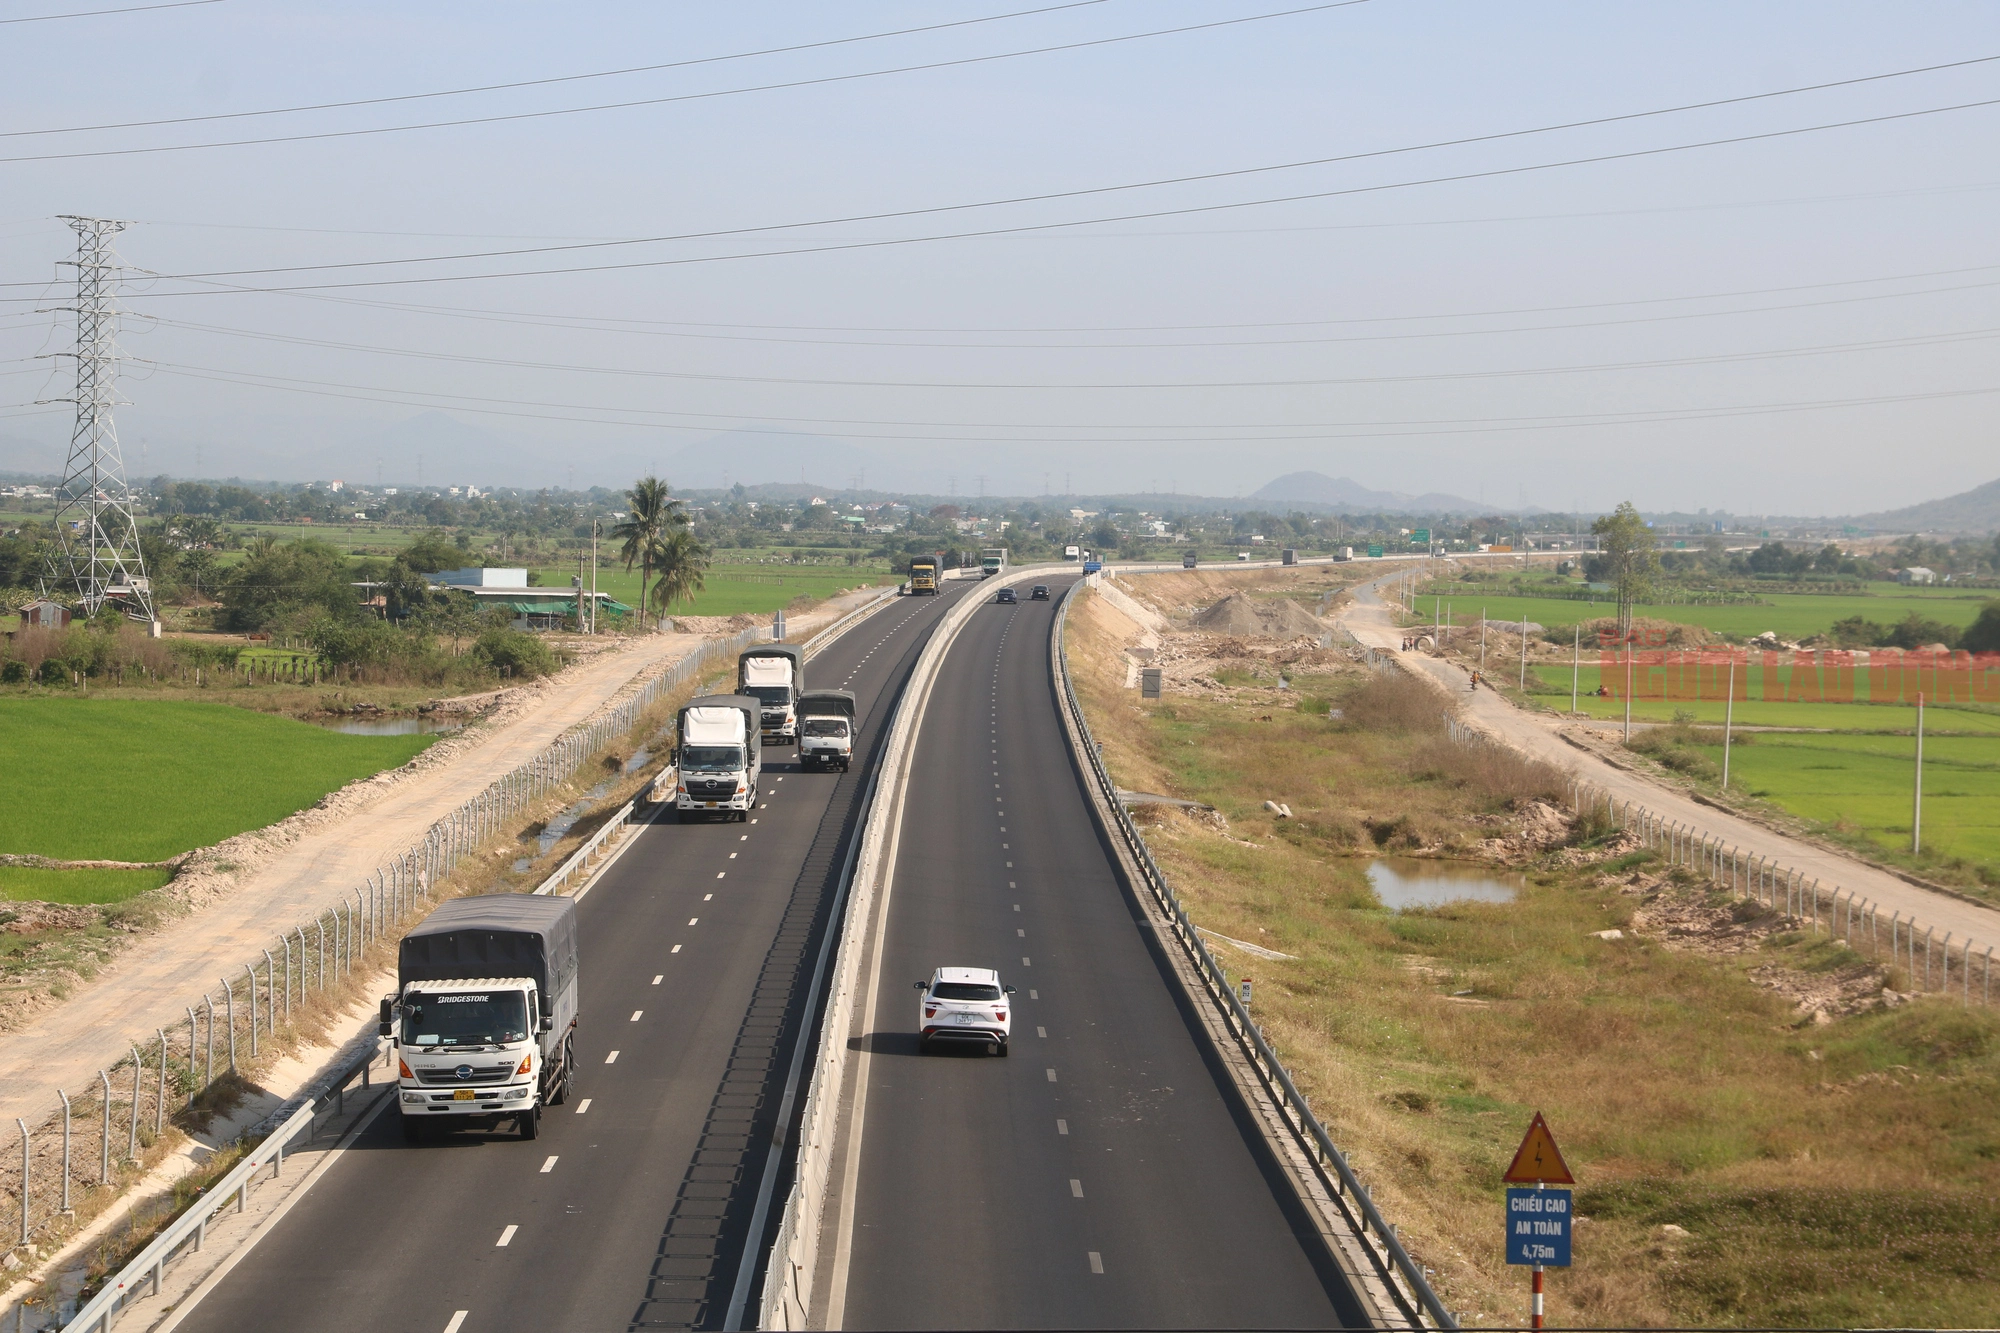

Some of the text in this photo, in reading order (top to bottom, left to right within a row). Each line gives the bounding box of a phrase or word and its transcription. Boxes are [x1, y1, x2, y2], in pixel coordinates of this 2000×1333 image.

[437, 995, 489, 1003] BRIDGESTONE
[1511, 1194, 1567, 1213] CHIỀU CAO
[1515, 1219, 1561, 1235] AN TOÀN
[1522, 1244, 1555, 1260] 4,75m
